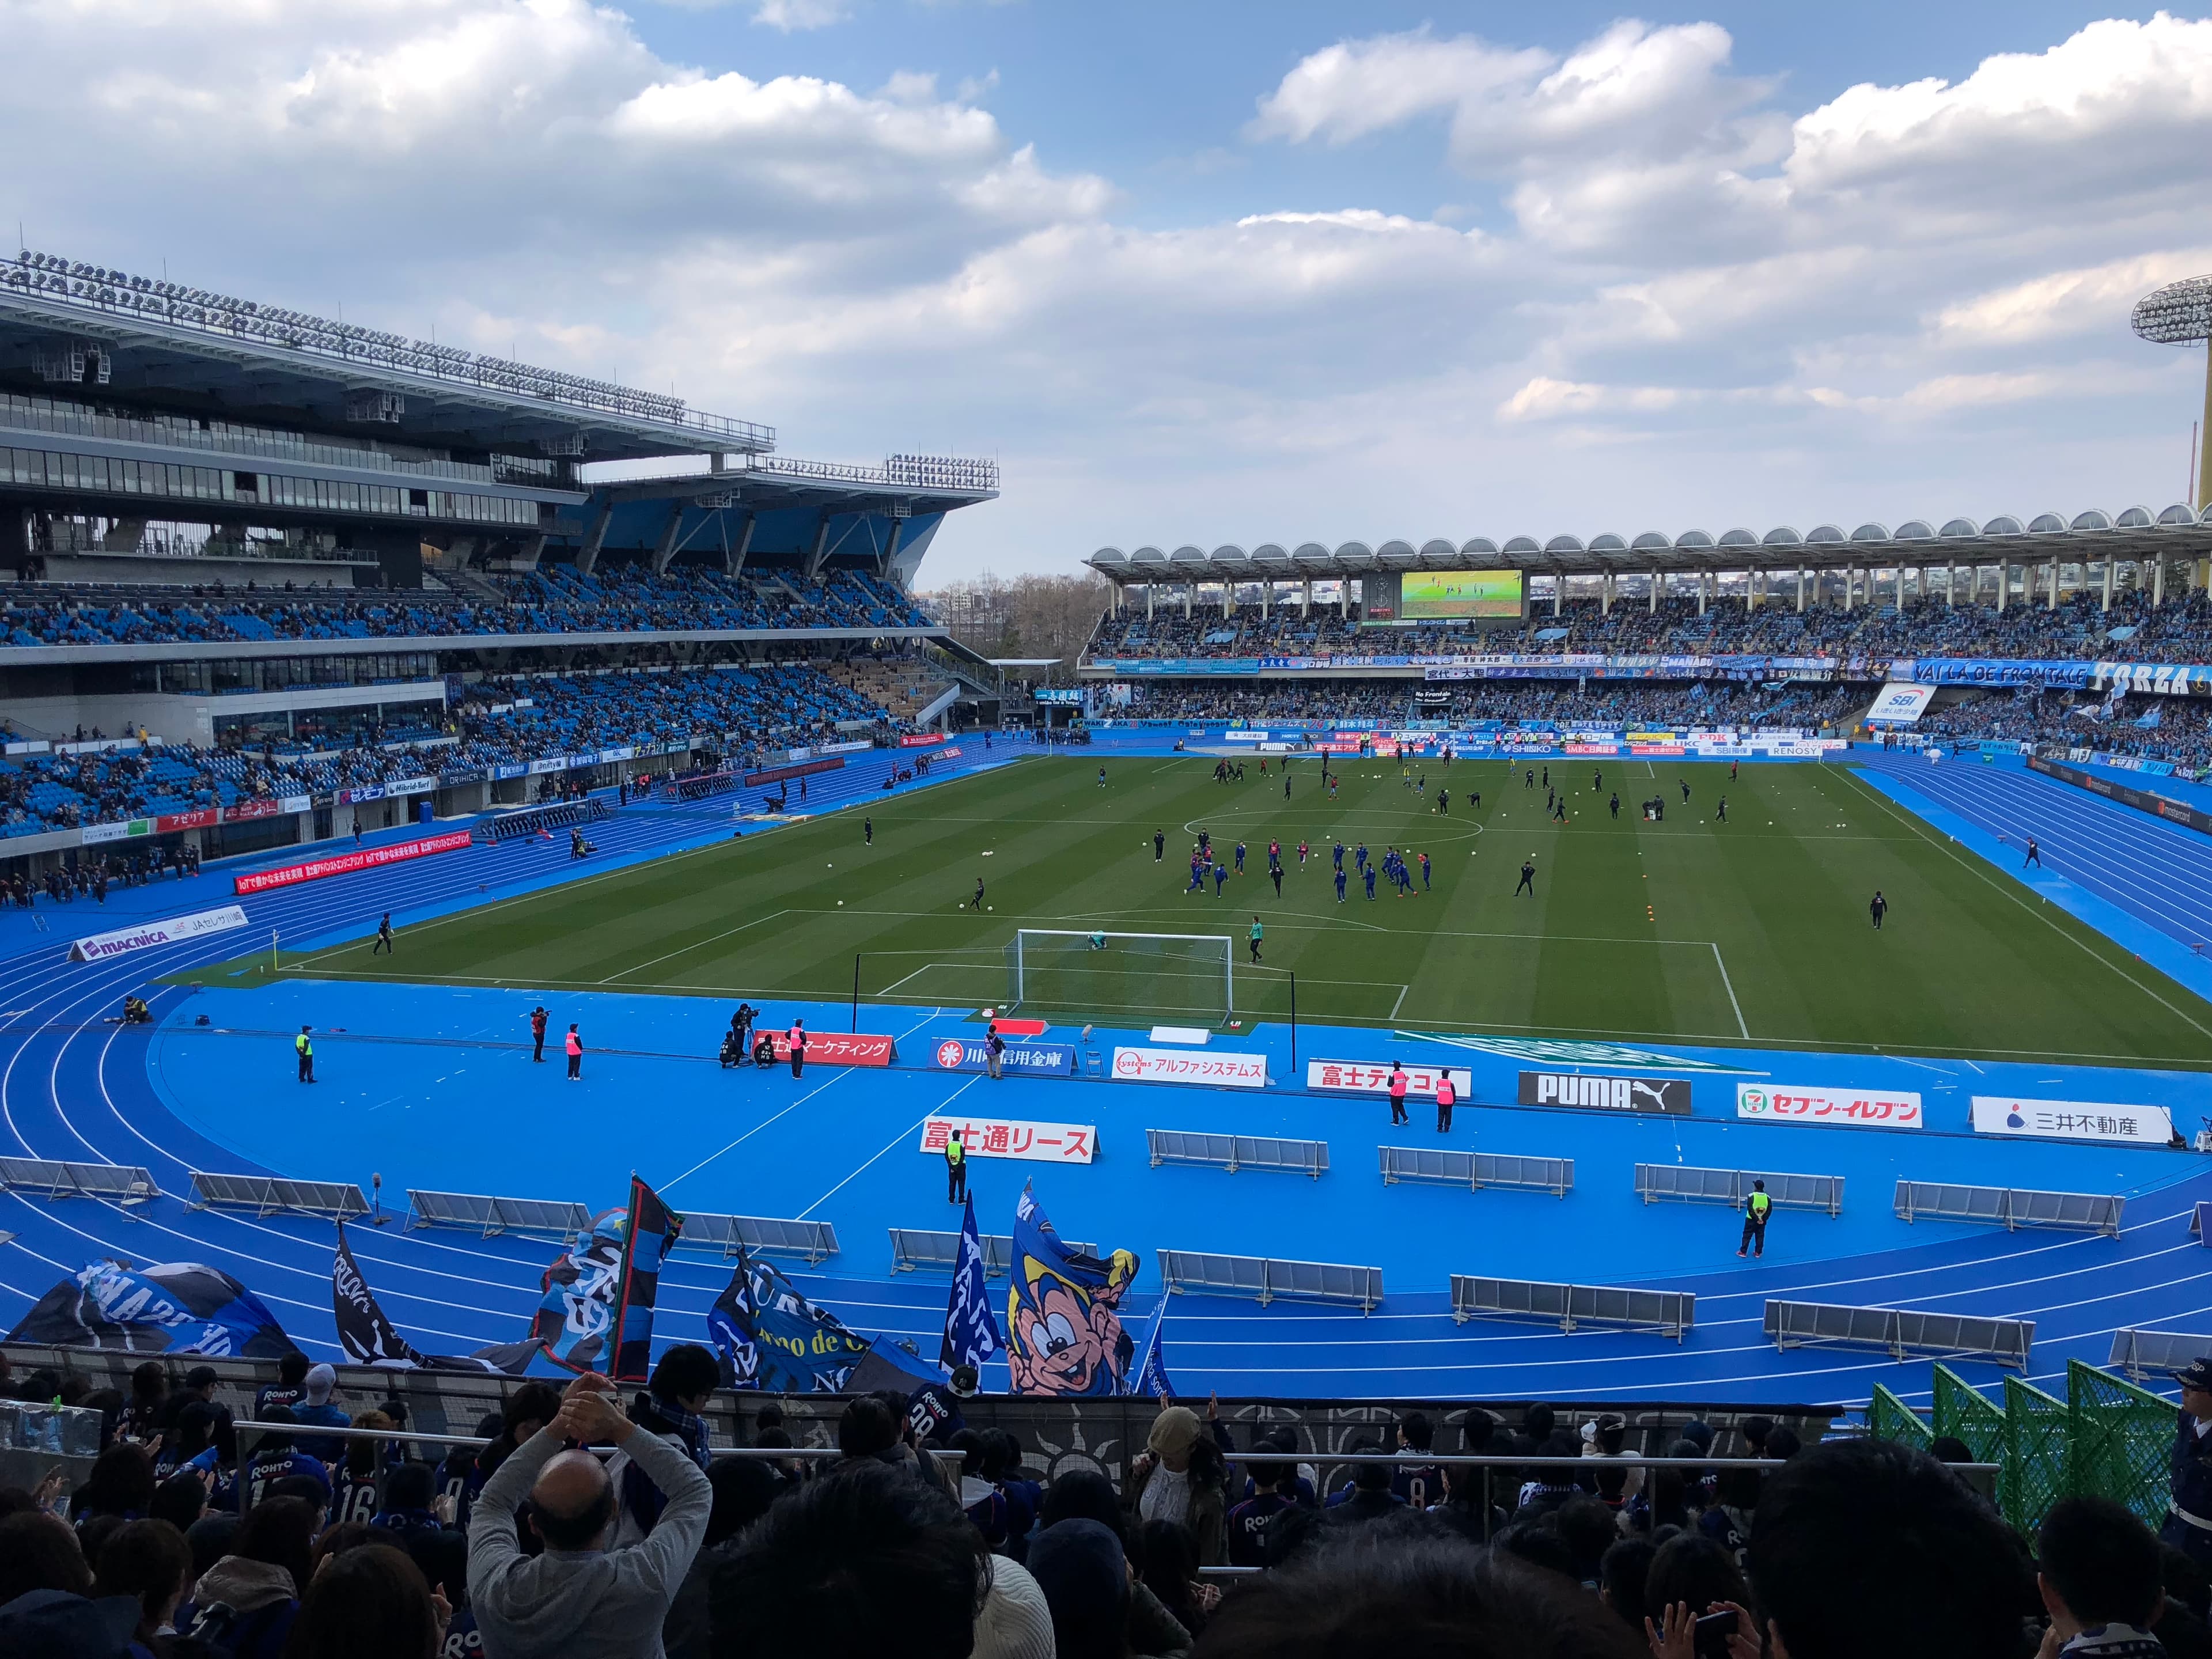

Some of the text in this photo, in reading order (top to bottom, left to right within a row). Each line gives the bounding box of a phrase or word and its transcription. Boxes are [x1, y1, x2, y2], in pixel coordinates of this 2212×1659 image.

[1668, 657, 1714, 667] MANABU
[1915, 662, 2086, 685] VAI LÁ DE FRONTALE
[2088, 662, 2191, 694] FORZA
[1888, 695, 1918, 706] SBI
[1129, 720, 1138, 728] 28
[1260, 743, 1286, 751] PUMA
[1512, 745, 1551, 753] SHINKO
[1774, 747, 1817, 755] RENOSY
[537, 758, 557, 772] @nifty
[449, 772, 480, 786] ORIHICA
[396, 781, 430, 794] Hibrid-Turf
[172, 812, 205, 825] アゼリア
[2164, 806, 2191, 823] mastercard
[192, 911, 243, 931] JAセレサ川崎
[965, 1047, 1063, 1067] 川信用金庫
[1154, 1058, 1263, 1078] アルファシステムズ
[1321, 1064, 1439, 1090] 富士テコ
[1537, 1075, 1632, 1108] PUMA
[2036, 1112, 2139, 1136] 三井不動産
[263, 1389, 298, 1402] ROHTO
[922, 1391, 948, 1418] ROHTO
[251, 1460, 293, 1480] ROHTO
